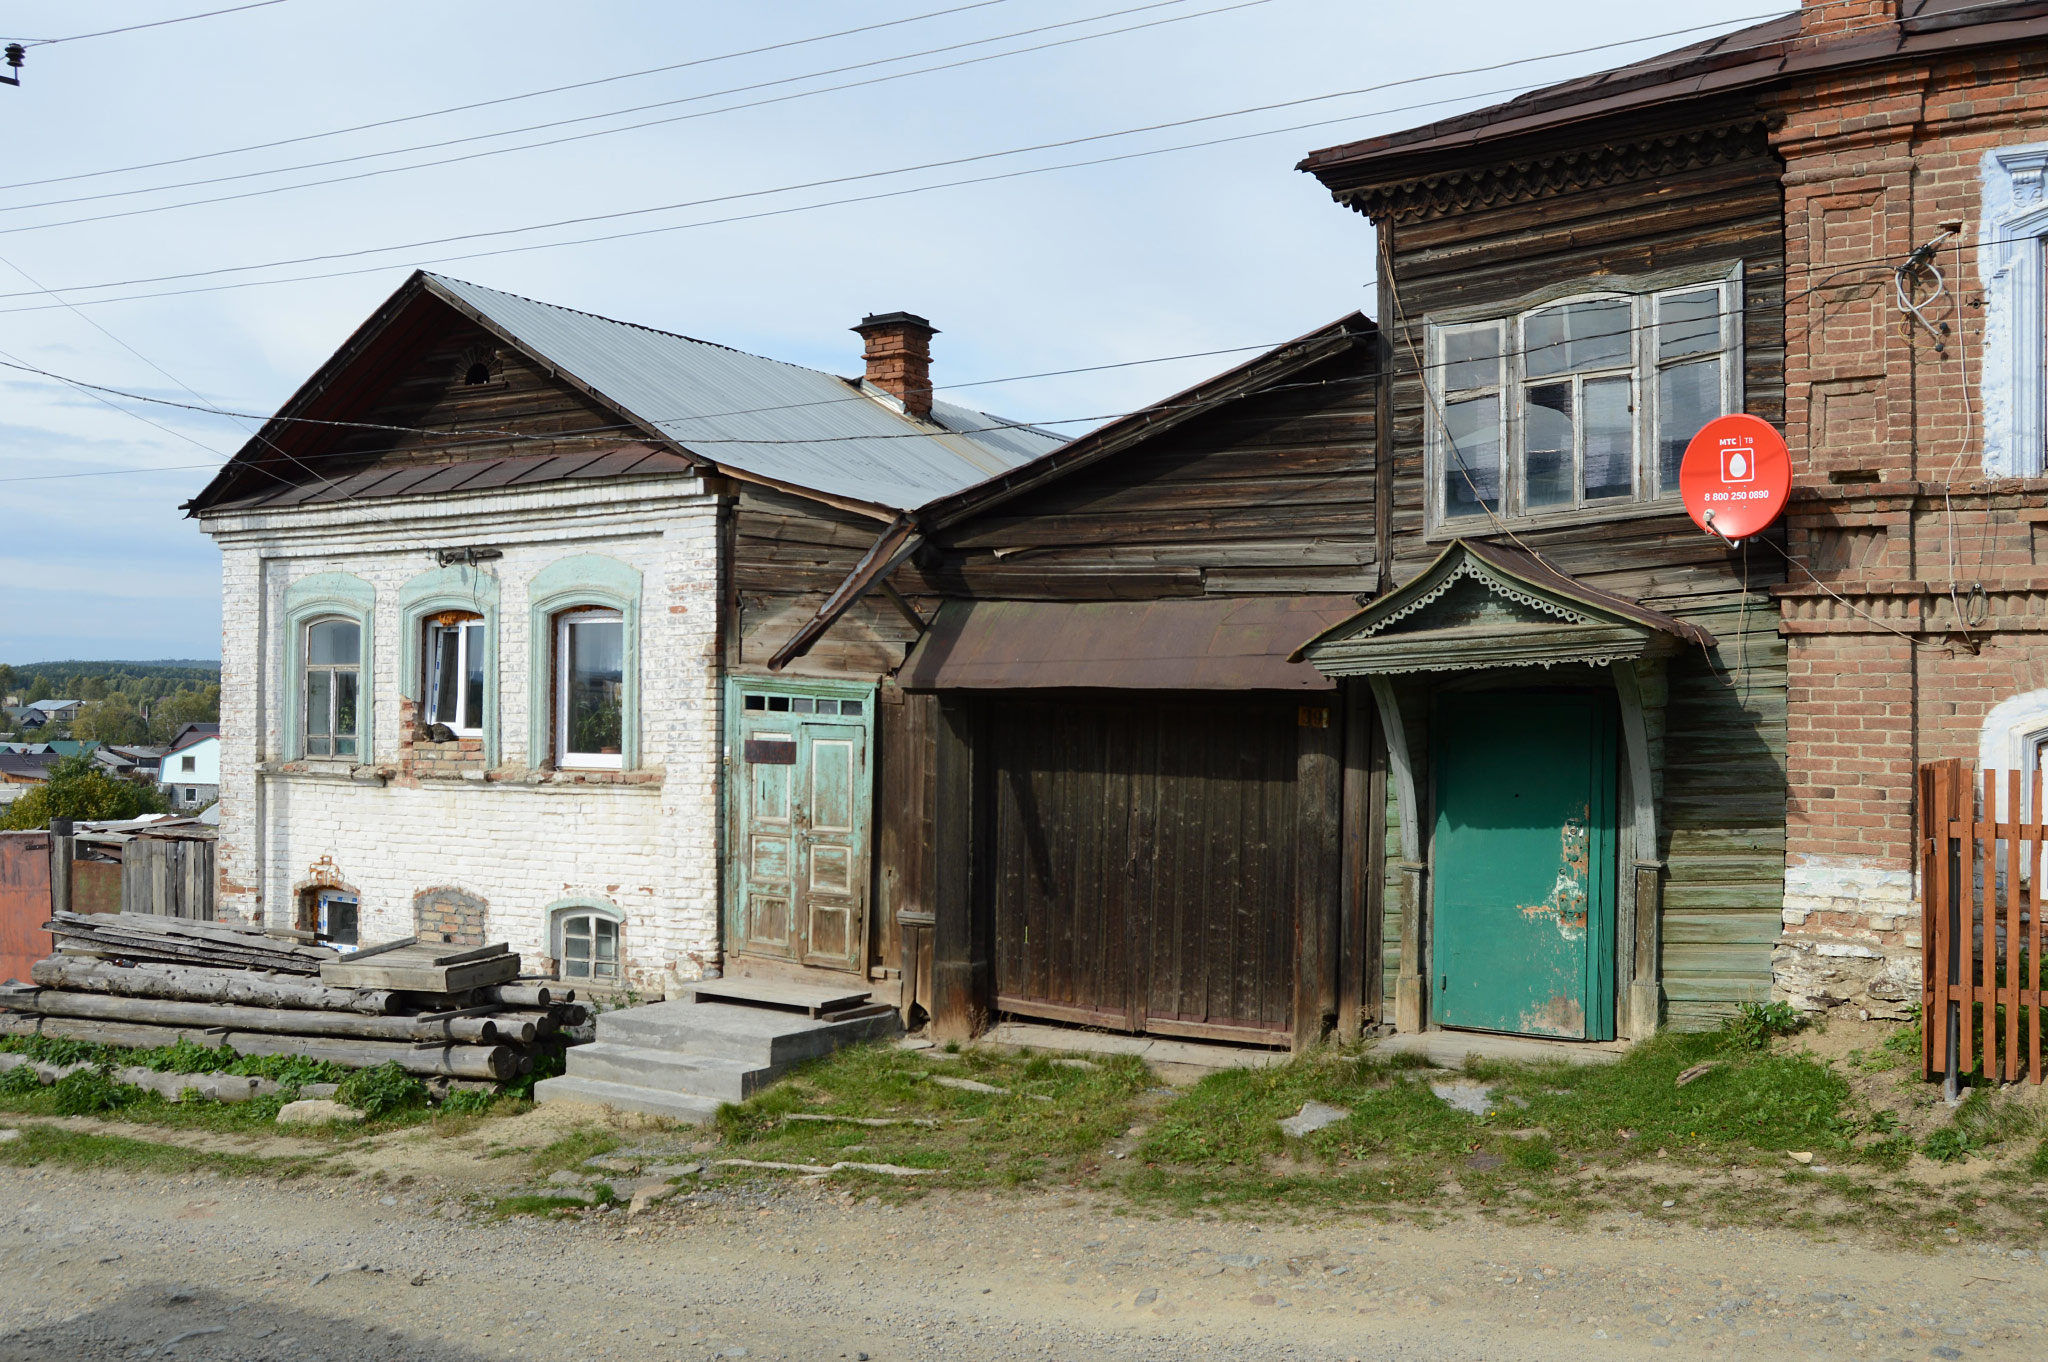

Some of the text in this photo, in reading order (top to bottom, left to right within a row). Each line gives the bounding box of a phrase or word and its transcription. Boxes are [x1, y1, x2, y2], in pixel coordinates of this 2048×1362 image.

[1719, 437, 1737, 446] МТС
[1704, 490, 1769, 502] 8 800 250 0890
